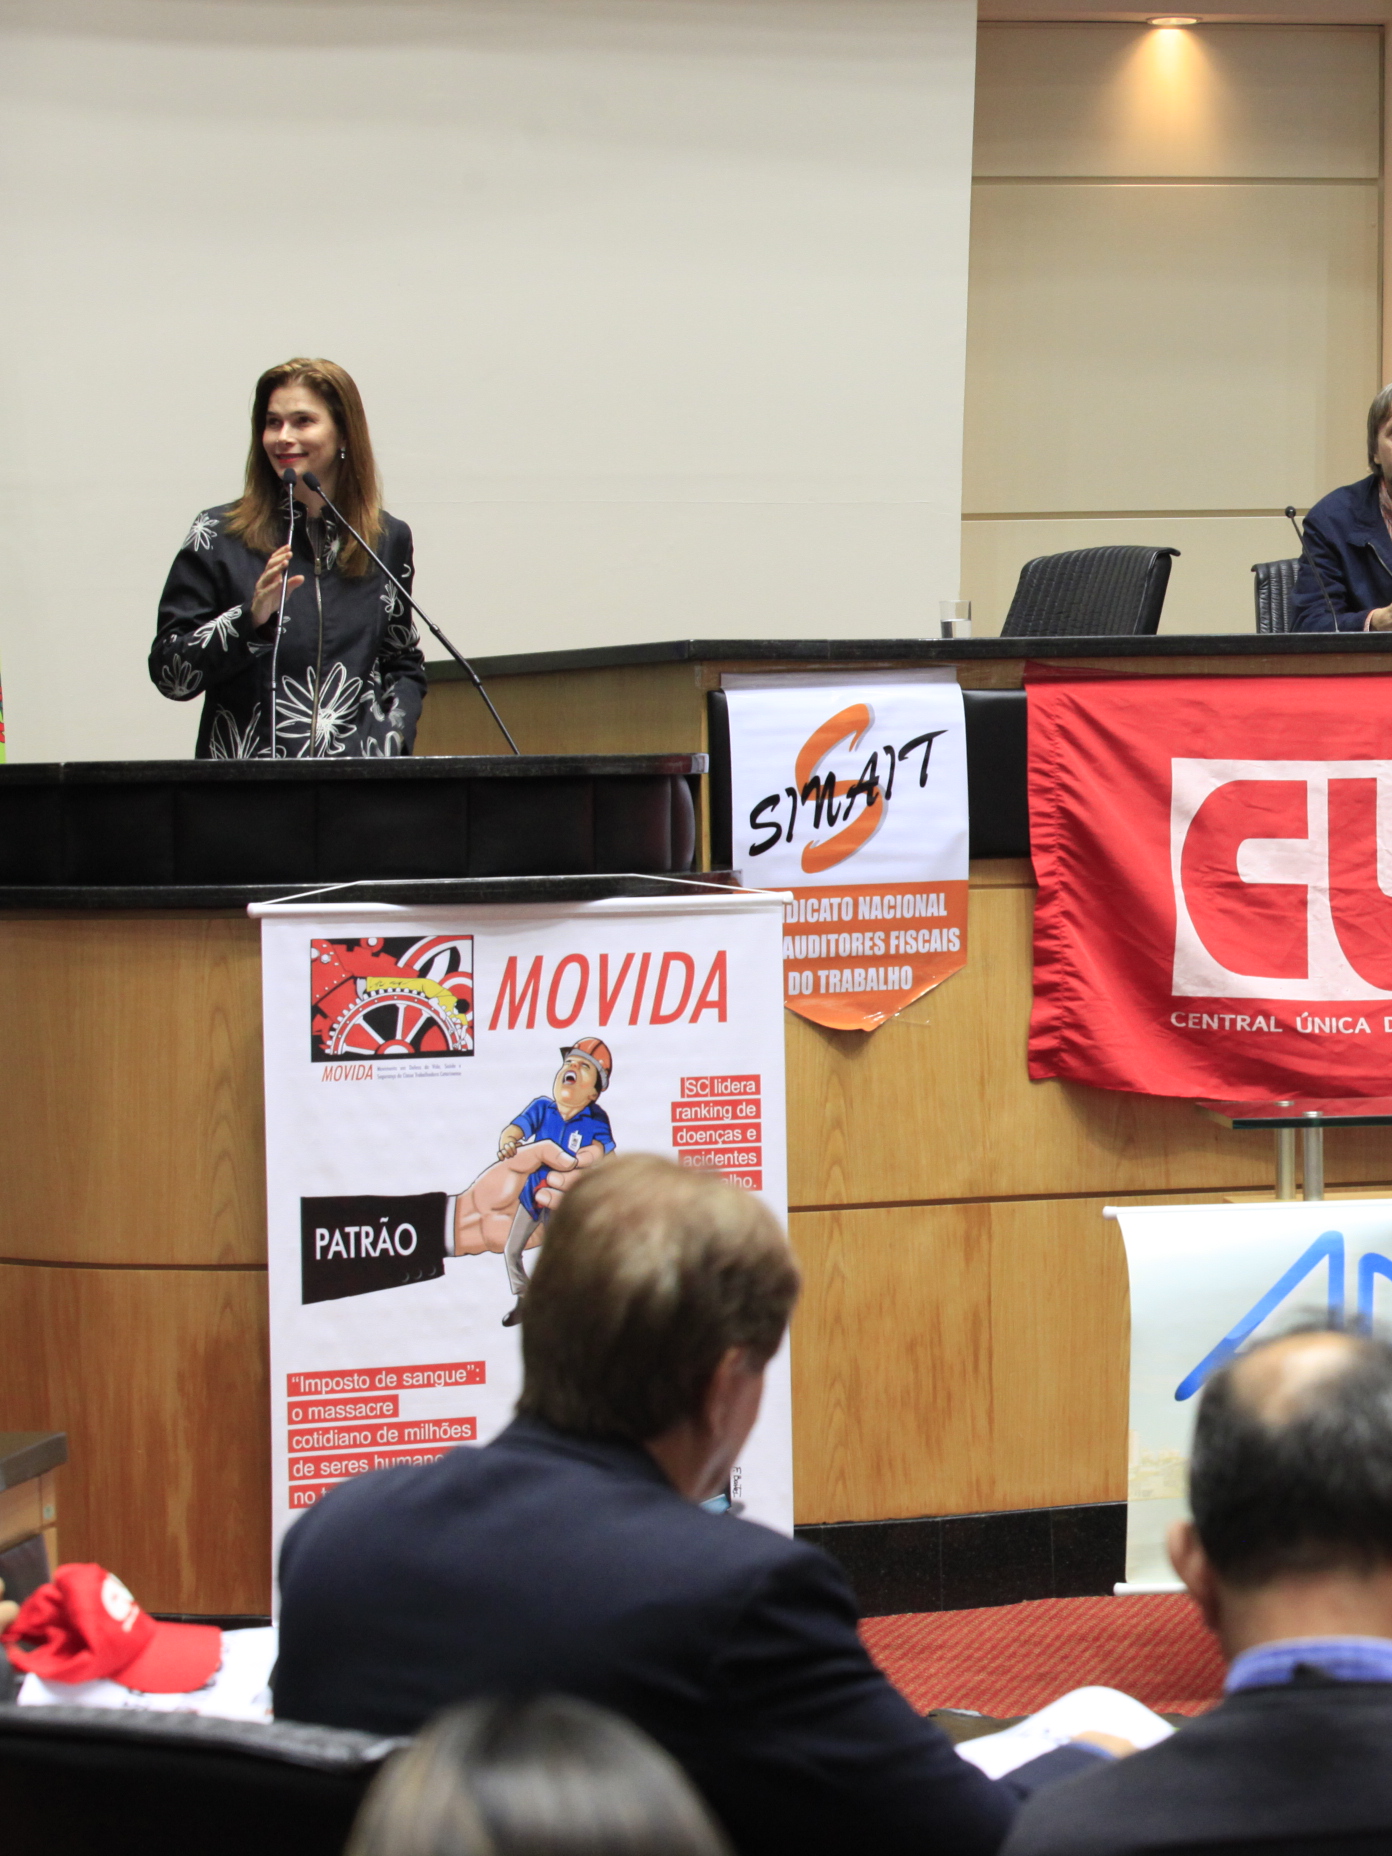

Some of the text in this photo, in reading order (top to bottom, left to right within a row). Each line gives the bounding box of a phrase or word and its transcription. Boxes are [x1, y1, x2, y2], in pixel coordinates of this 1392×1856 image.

[858, 893, 947, 920] NACIONAL
[783, 927, 961, 959] AUDITORES FISCAIS
[488, 950, 727, 1030] MOVIDA
[788, 965, 913, 995] DO TRABALHO
[1170, 1010, 1283, 1033] CENTRAL
[1295, 1011, 1371, 1035] ÚNICA
[322, 1064, 373, 1082] MOVIDA
[685, 1078, 757, 1096] SC lidera
[676, 1101, 757, 1121] ranking de
[676, 1128, 757, 1145] doenças e
[683, 1151, 757, 1167] acidentes
[315, 1217, 418, 1261] PATRÃO
[375, 1371, 397, 1387] de
[292, 1401, 394, 1421] o massacre
[292, 1422, 472, 1449] cotidiano de milhões
[293, 1460, 315, 1477] de
[320, 1458, 369, 1475] seres
[294, 1490, 316, 1505] no
